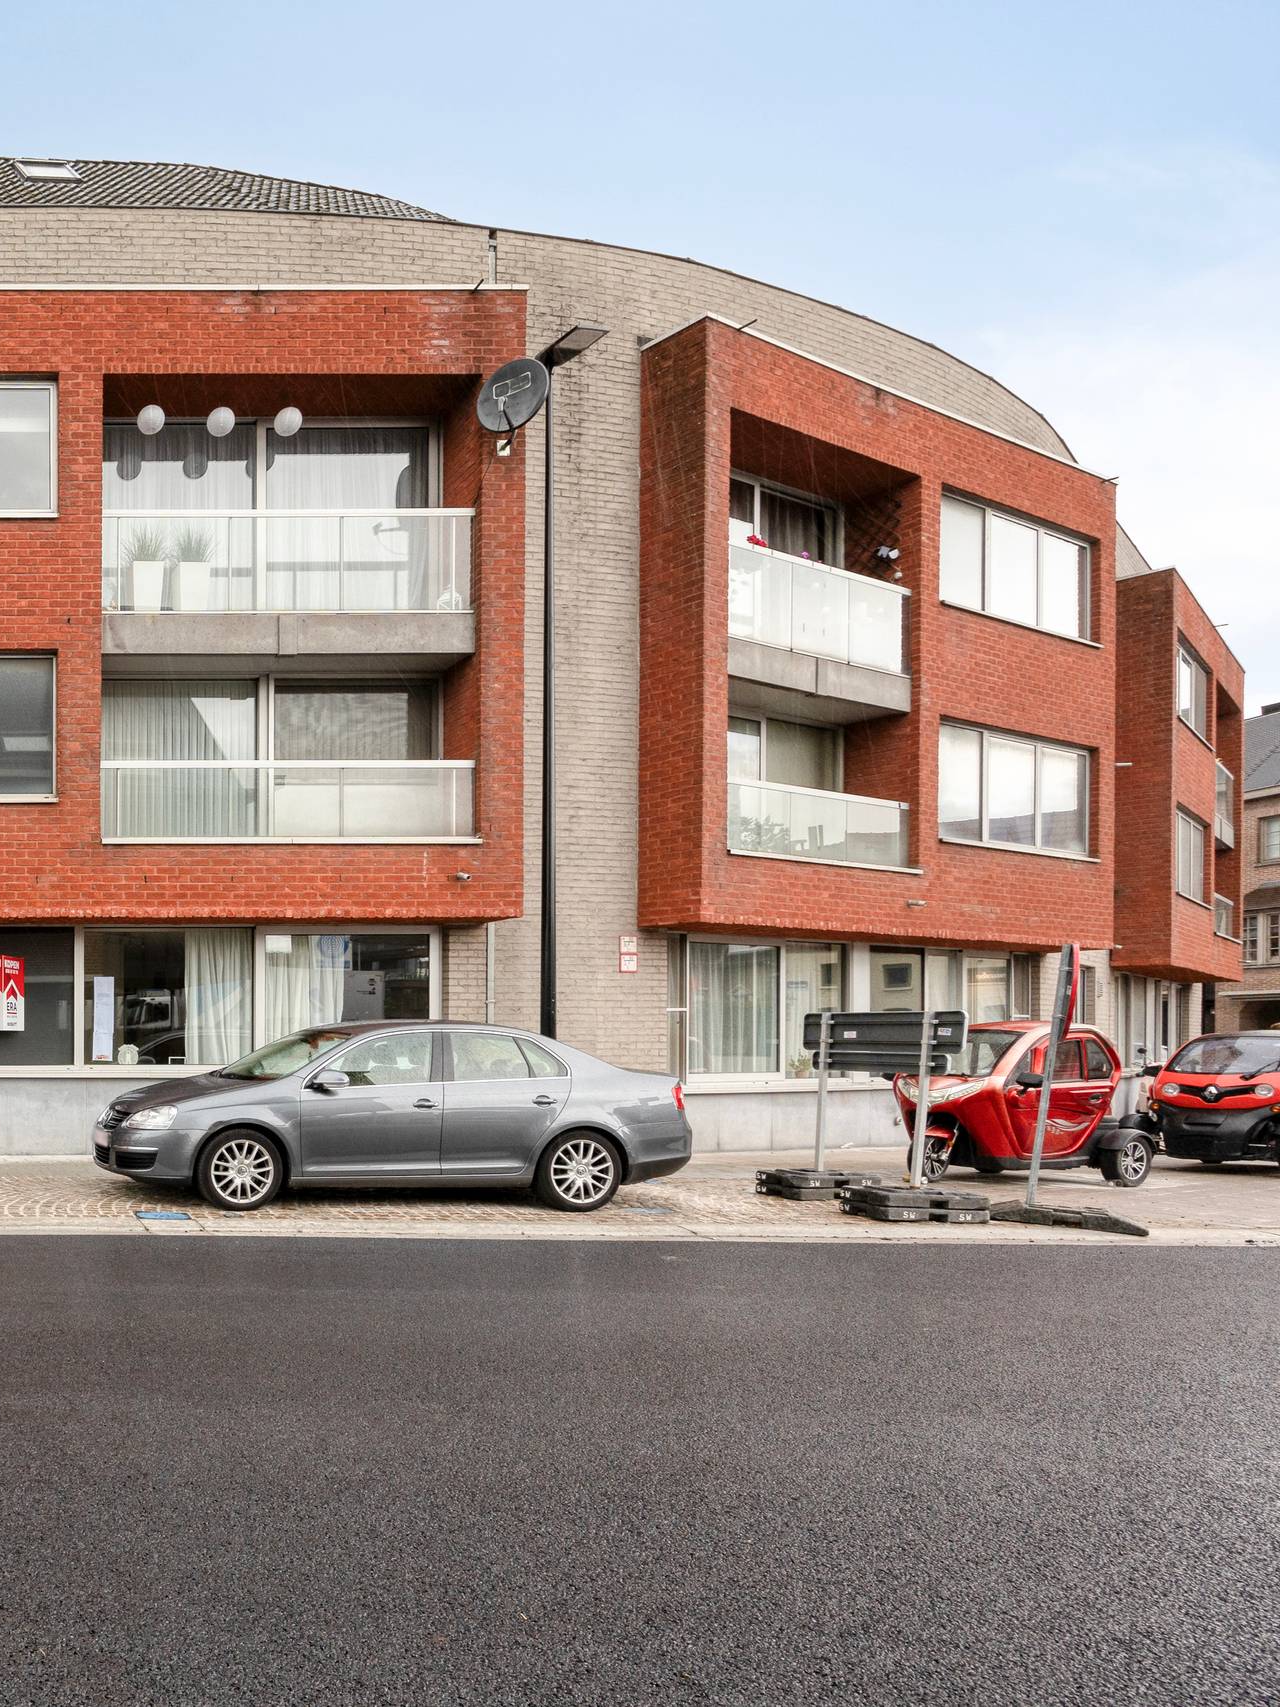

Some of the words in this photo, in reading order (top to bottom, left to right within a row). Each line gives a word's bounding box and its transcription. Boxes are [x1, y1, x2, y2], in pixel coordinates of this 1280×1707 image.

[6, 1002, 18, 1011] ERA
[840, 1190, 850, 1198] SW
[902, 1211, 916, 1219] SW
[959, 1213, 972, 1221] SW
